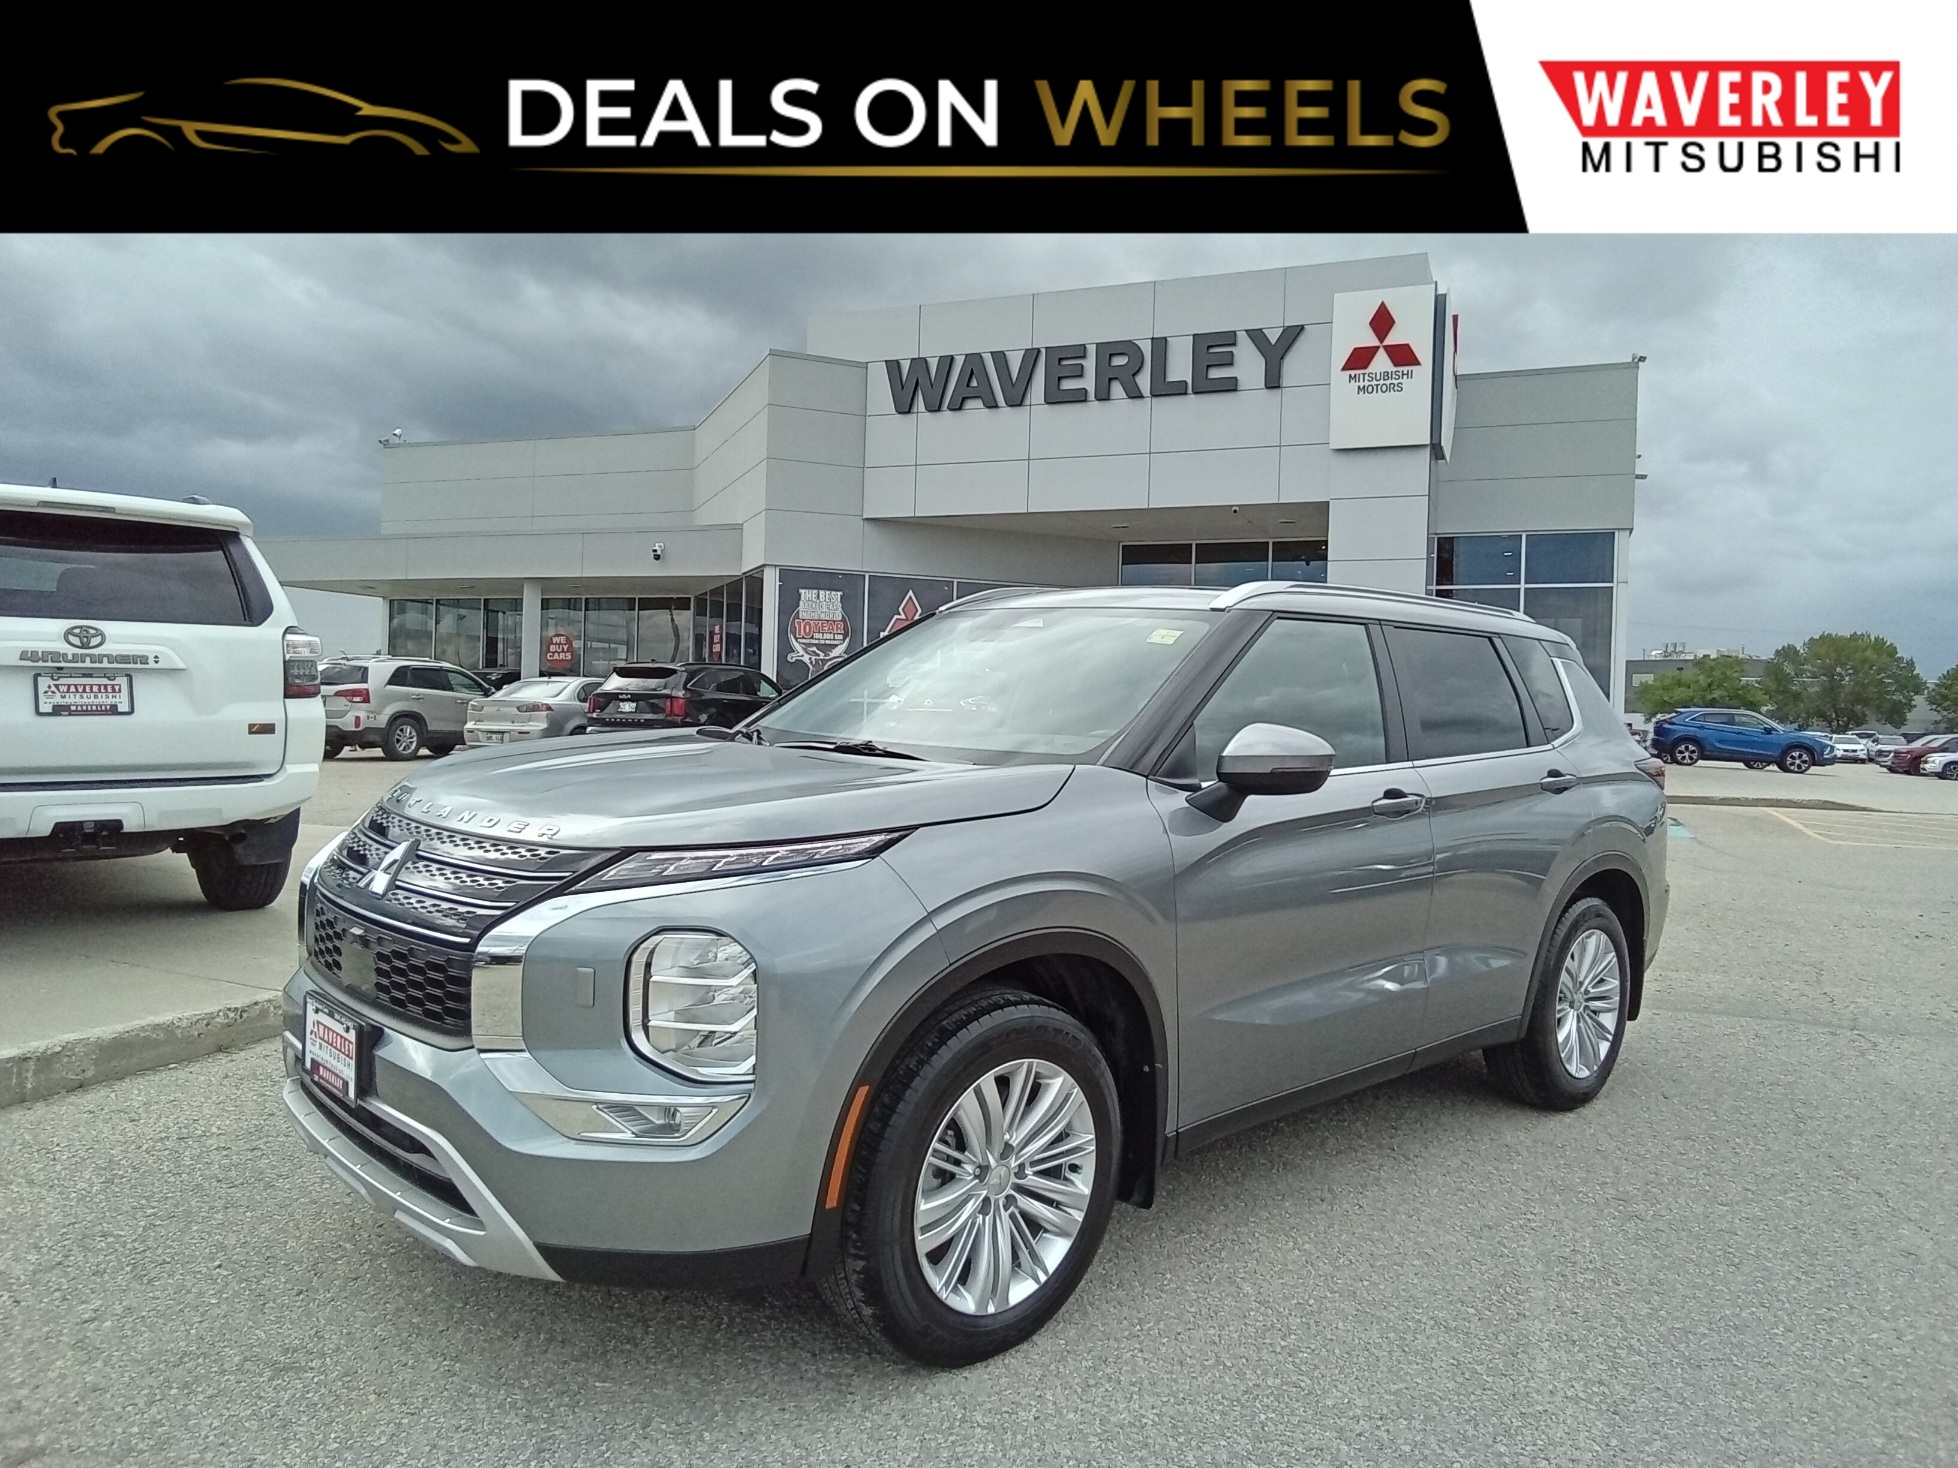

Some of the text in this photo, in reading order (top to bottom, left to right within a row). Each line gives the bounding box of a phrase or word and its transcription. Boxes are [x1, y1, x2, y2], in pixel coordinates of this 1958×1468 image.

[884, 325, 1304, 414] WAVERLEY
[1348, 369, 1414, 384] MITSUBISHI
[1357, 382, 1404, 396] MOTORS
[799, 589, 843, 603] THE BEST
[795, 619, 844, 638] 10 YEAR
[552, 636, 567, 644] WE
[549, 644, 569, 652] BUY
[547, 652, 572, 661] CARS
[58, 684, 121, 693] WAVERLEY
[318, 1023, 353, 1060] WAVERLEY
[319, 1042, 353, 1072] MITSUBISHI
